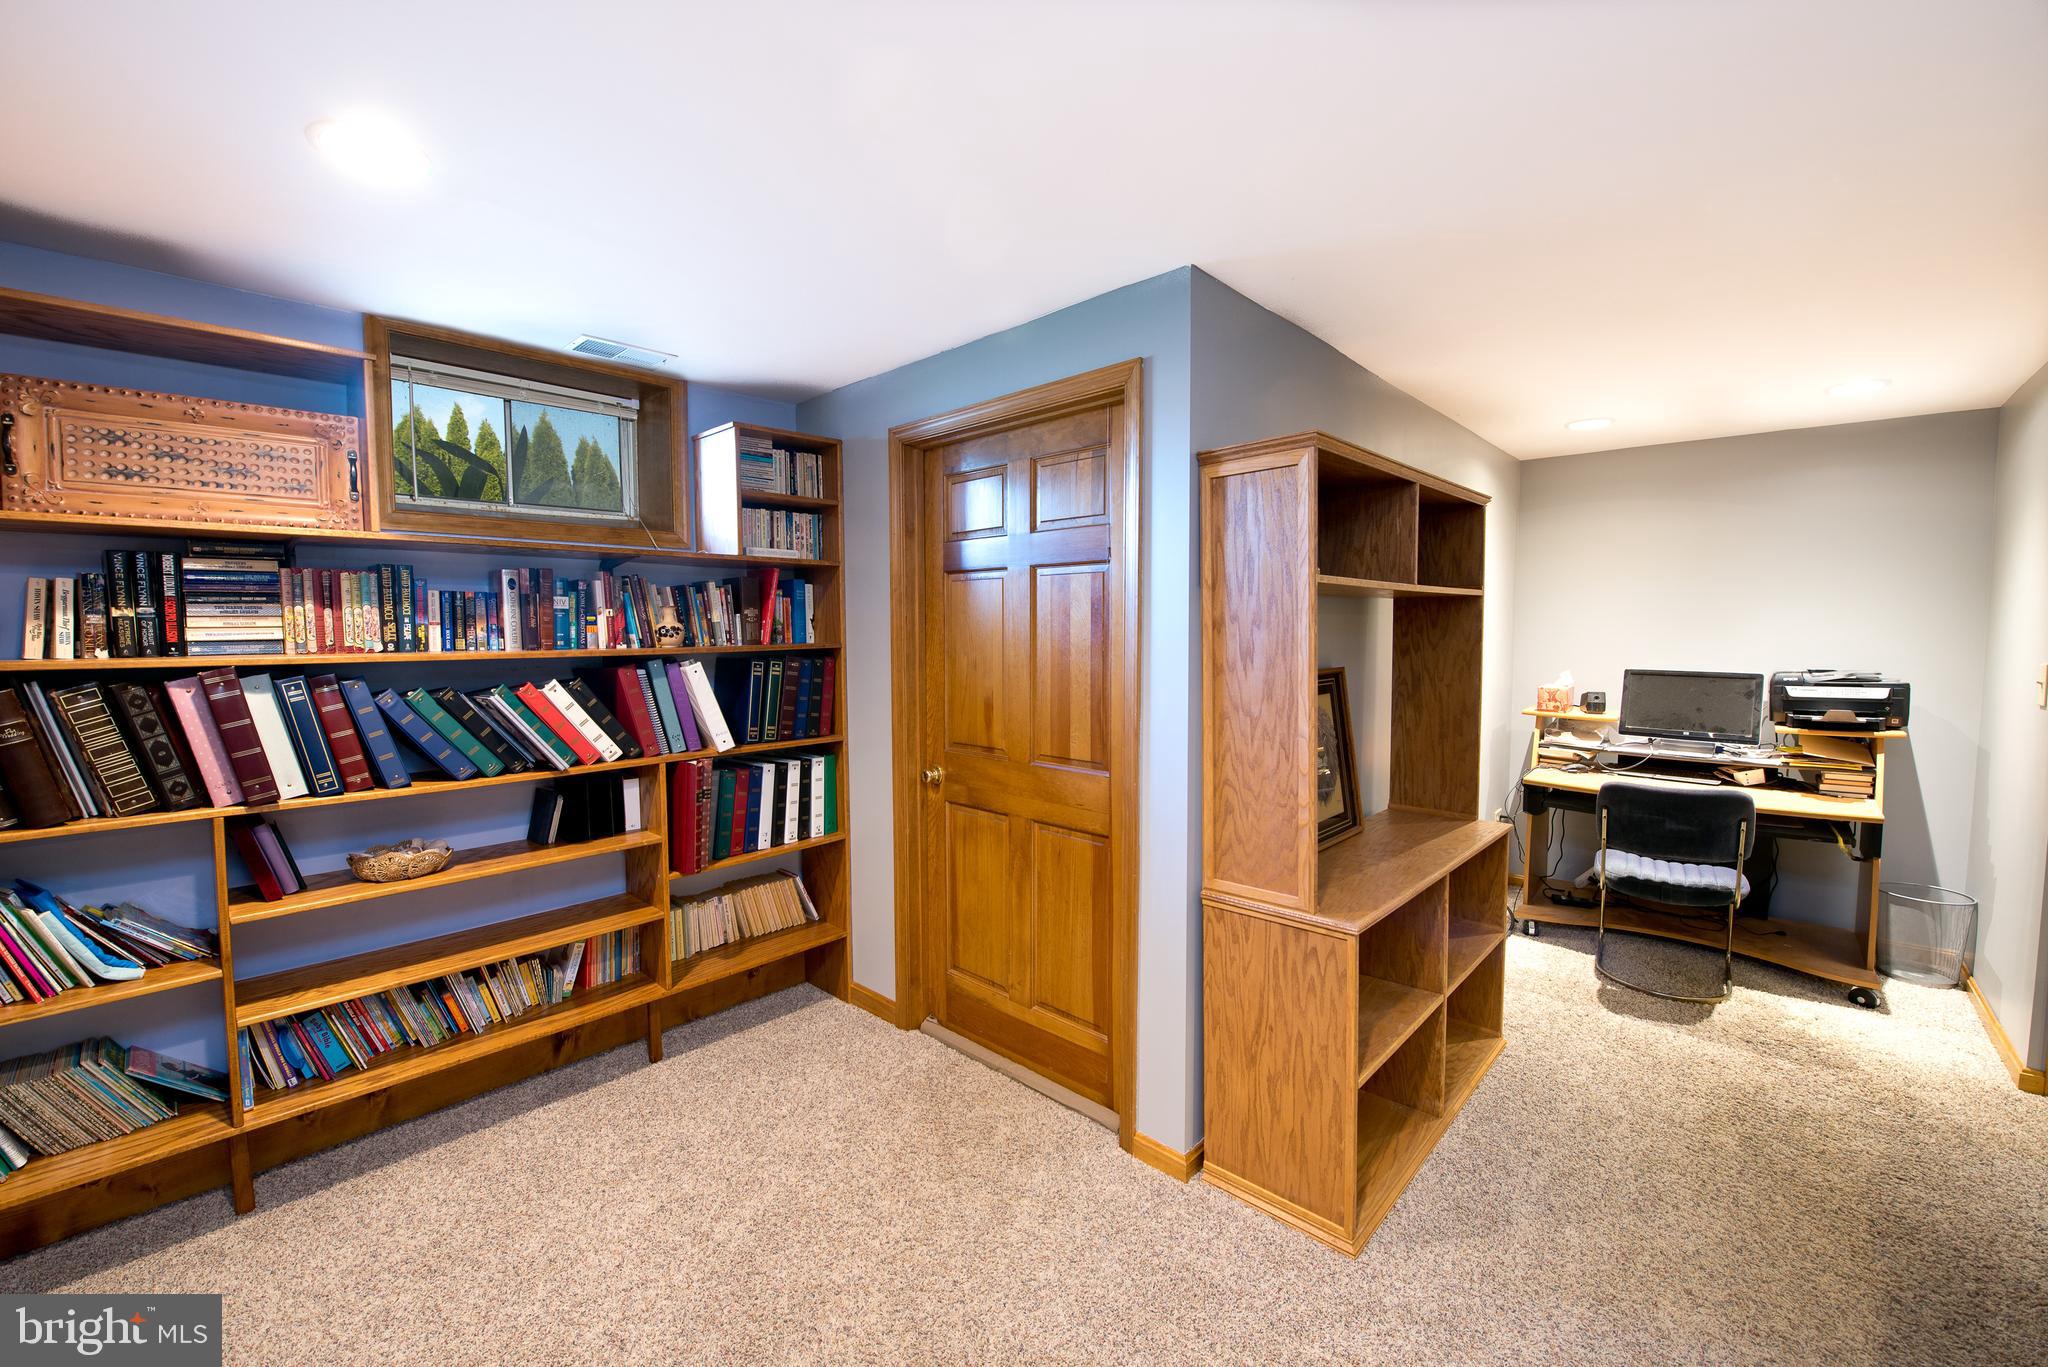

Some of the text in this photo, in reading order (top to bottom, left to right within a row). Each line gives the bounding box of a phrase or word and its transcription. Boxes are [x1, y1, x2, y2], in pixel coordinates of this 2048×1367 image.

[114, 553, 126, 606] VINCE FLYNN
[136, 554, 147, 606] VINCE FLYNN
[162, 555, 176, 596] ROBERT LUDLUM
[401, 570, 411, 615] DAVID BALDACCI
[165, 601, 178, 642] SCORPIO ILLUSION
[382, 589, 394, 620] BALDACCI
[322, 1030, 332, 1048] Bible
